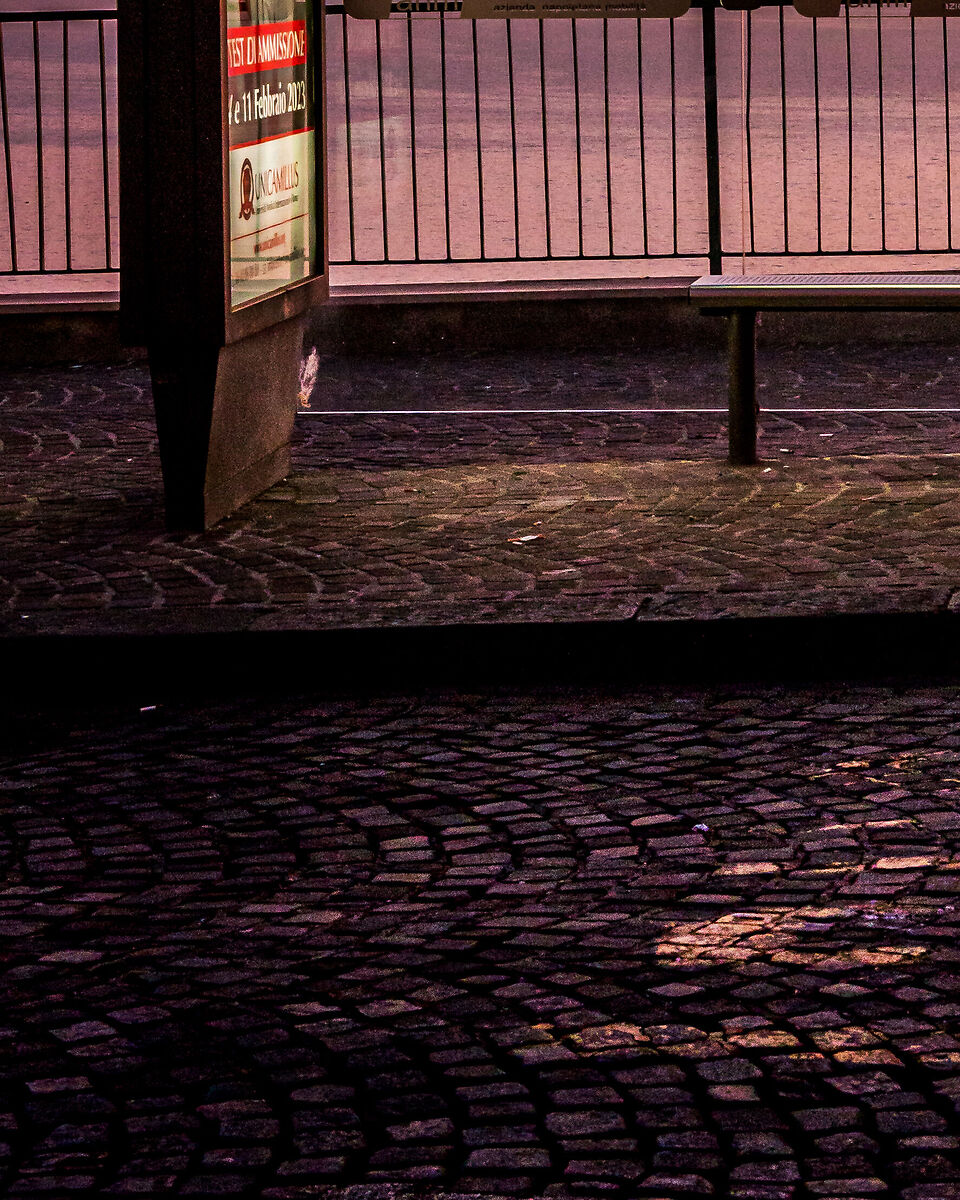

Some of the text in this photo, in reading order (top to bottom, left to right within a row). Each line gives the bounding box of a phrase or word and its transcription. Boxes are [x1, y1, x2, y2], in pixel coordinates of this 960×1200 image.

[227, 29, 305, 68] TEST DI AMMISSIONE
[234, 100, 240, 124] e
[242, 91, 252, 123] 11
[254, 82, 286, 120] Febbraio
[287, 81, 306, 113] 2023
